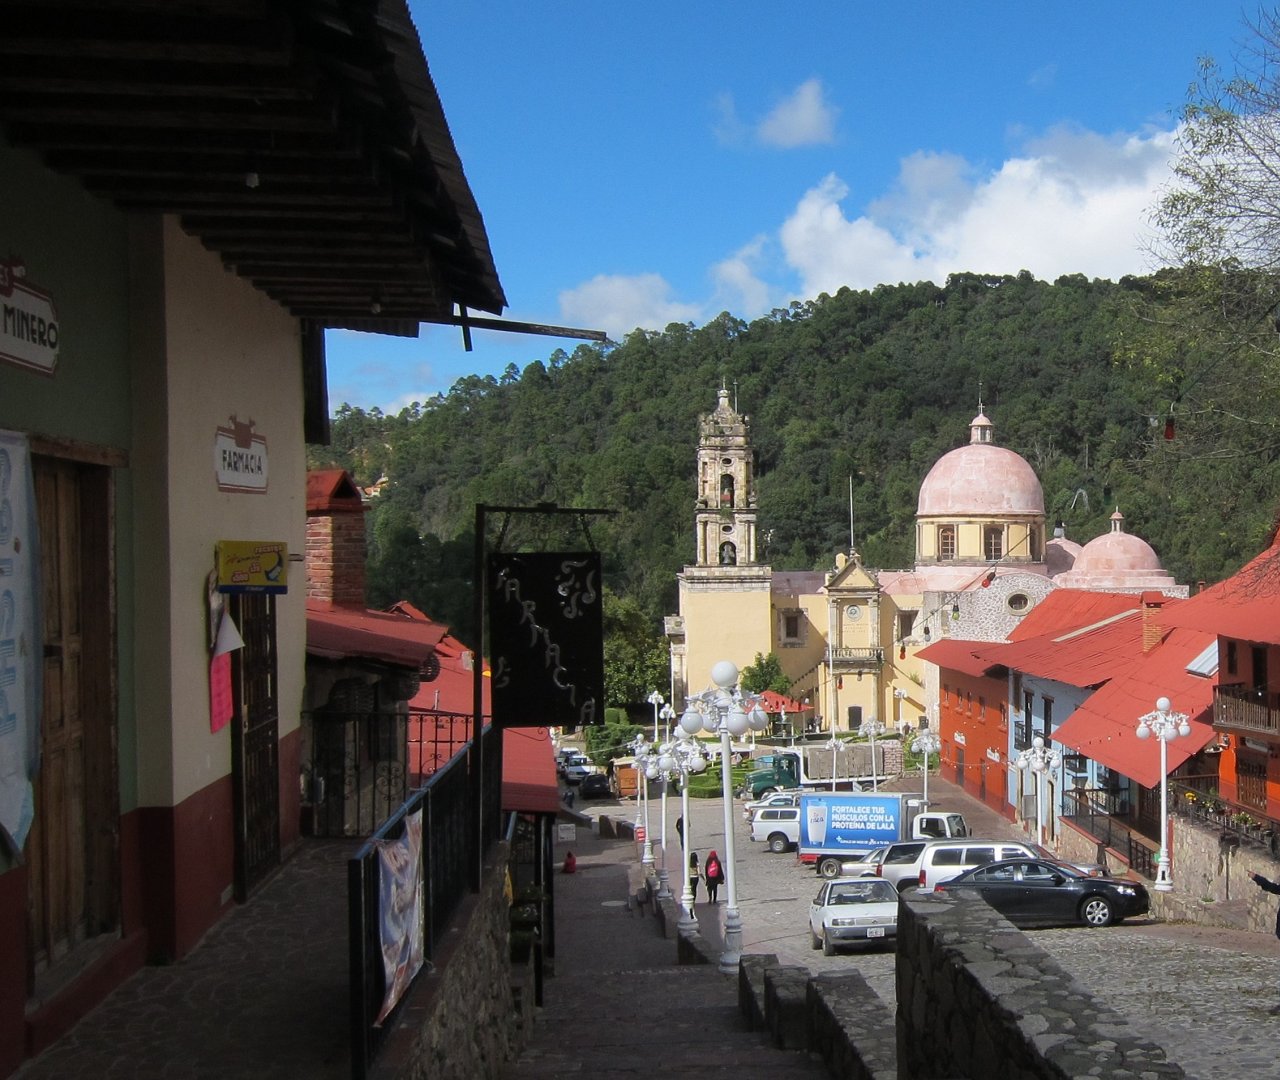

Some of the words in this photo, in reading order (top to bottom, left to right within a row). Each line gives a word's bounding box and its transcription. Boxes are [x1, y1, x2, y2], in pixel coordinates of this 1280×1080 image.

[3, 304, 58, 349] MINERO
[222, 449, 263, 475] FARMACIA
[831, 805, 871, 814] FORTALECE
[872, 806, 885, 814] TUS
[868, 814, 884, 822] CON
[885, 814, 895, 822] LA
[866, 822, 876, 830] DE
[876, 822, 895, 830] LALA
